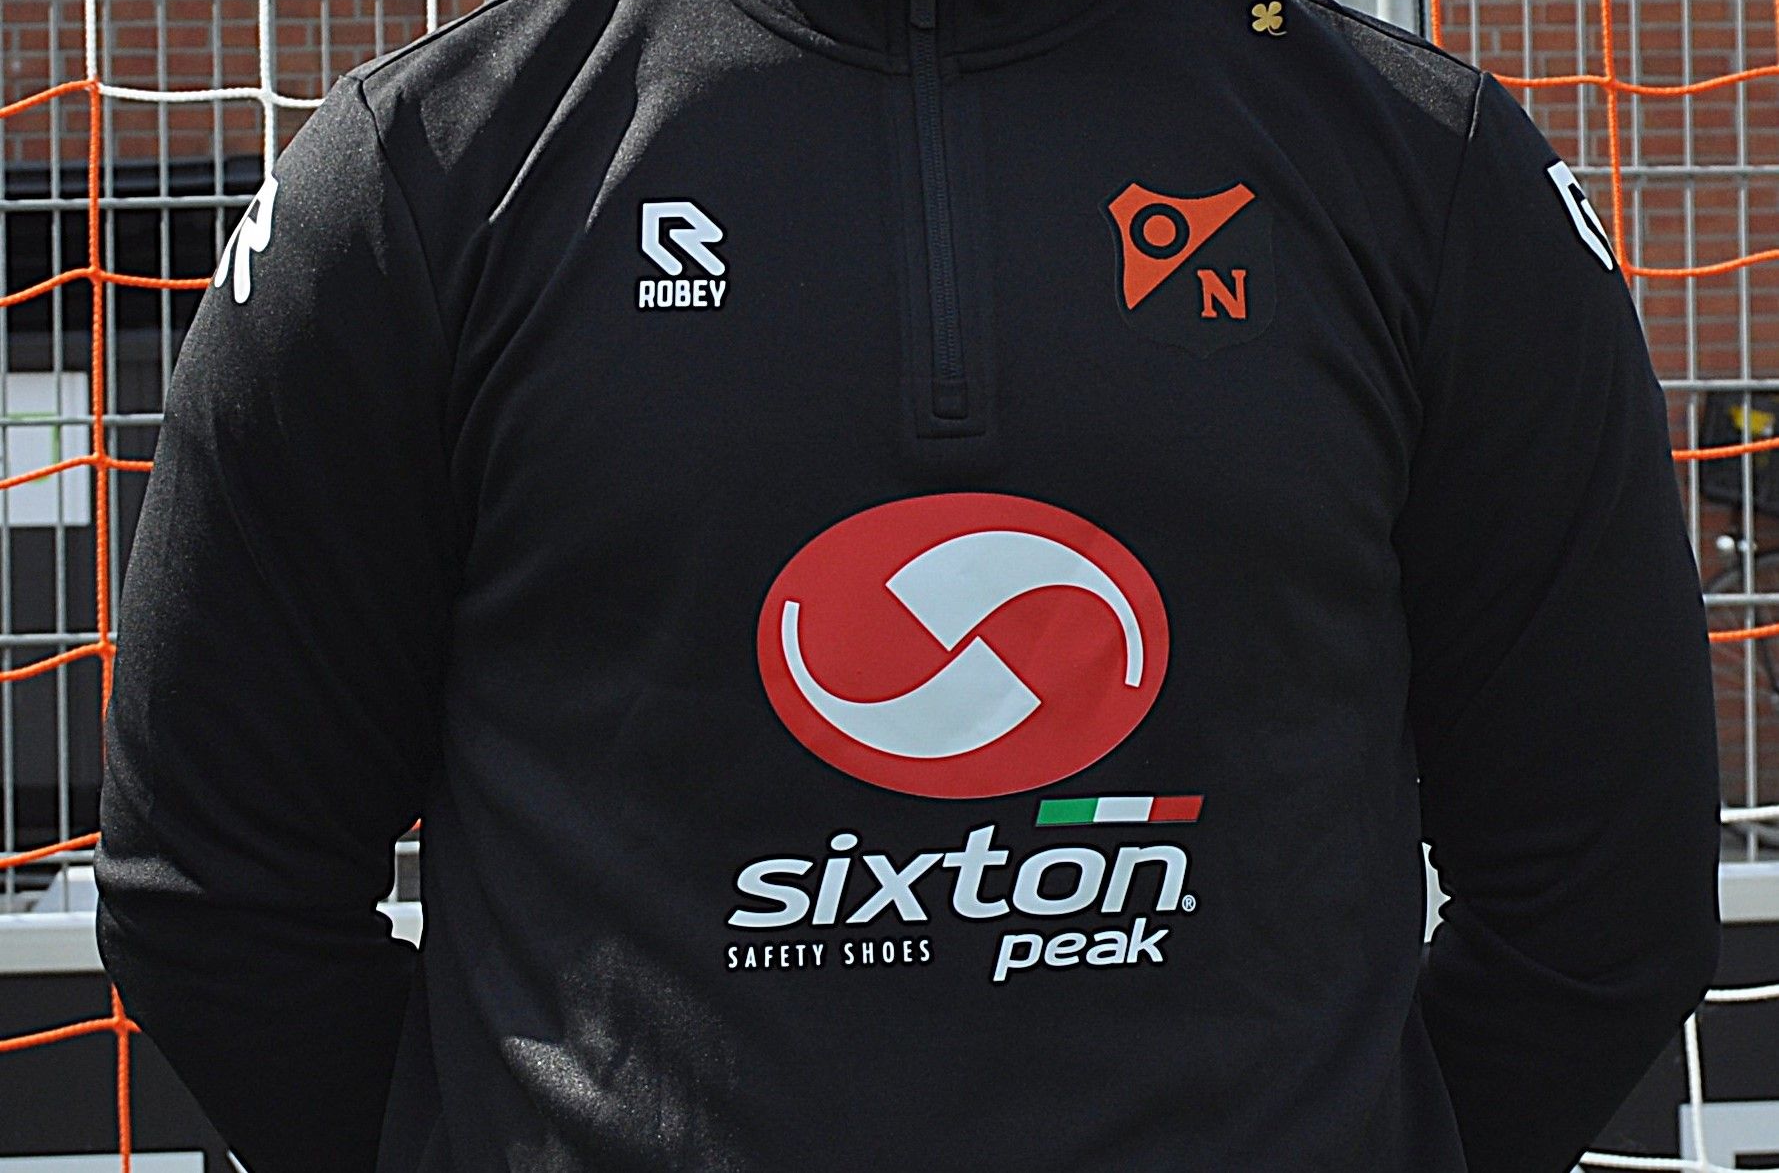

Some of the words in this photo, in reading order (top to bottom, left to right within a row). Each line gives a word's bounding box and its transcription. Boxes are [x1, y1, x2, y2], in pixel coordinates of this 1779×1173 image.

[638, 279, 727, 308] ROBEY
[727, 824, 1188, 928] sixton
[727, 943, 825, 969] SAFETY
[843, 939, 931, 965] SHOES
[992, 917, 1169, 982] peak
